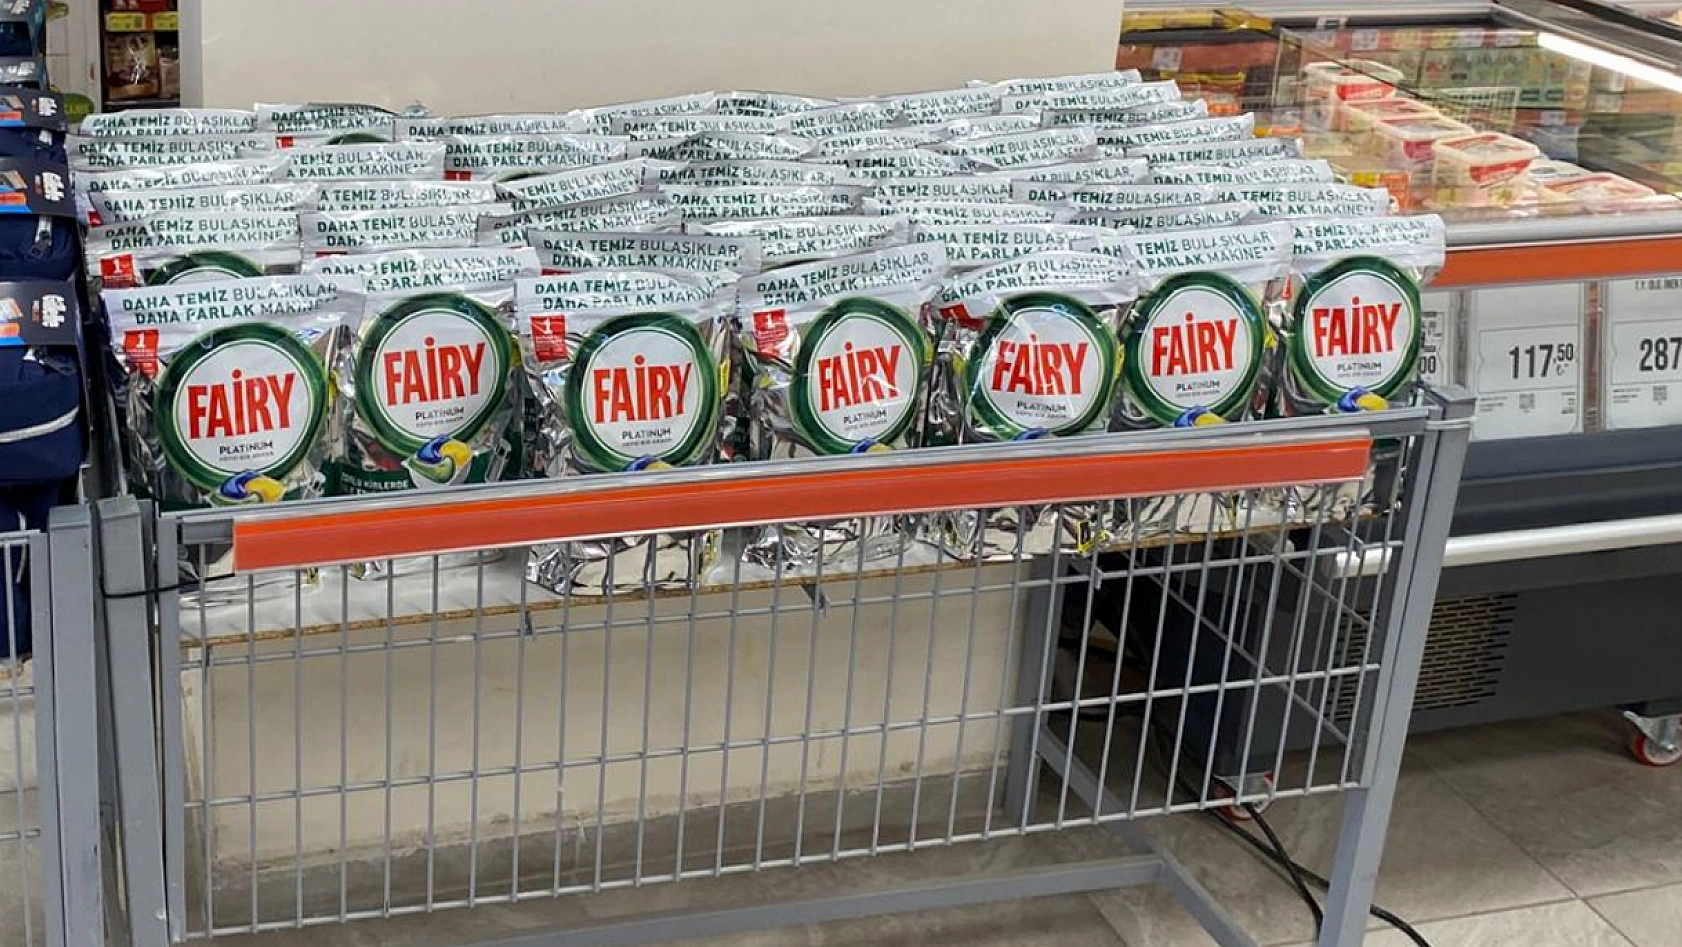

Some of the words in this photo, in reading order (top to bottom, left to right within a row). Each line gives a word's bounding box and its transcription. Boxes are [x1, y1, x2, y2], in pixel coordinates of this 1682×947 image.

[130, 113, 170, 127] TEMİZ
[1090, 111, 1124, 123] TEMİZ
[409, 126, 445, 137] DAHA
[450, 121, 486, 135] TEMİZ
[660, 118, 697, 132] TEMİZ
[122, 139, 164, 154] TEMİZ
[446, 143, 481, 154] DAHA
[487, 140, 523, 153] TEMİZ
[129, 154, 186, 166] PARLAK
[453, 157, 488, 168] DAHA
[492, 154, 543, 167] PARLAK
[855, 156, 896, 168] TEMİZ
[1179, 149, 1212, 163] TEMİZ
[300, 165, 355, 178] PARLAK
[660, 168, 696, 180] DAHA
[701, 163, 740, 178] TEMİZ
[335, 188, 377, 202] TEMİZ
[889, 182, 928, 197] TEMİZ
[1241, 188, 1284, 202] TEMİZ
[149, 195, 195, 211] TEMİZ
[715, 191, 757, 205] TEMİZ
[1073, 192, 1113, 204] TEMİZ
[722, 205, 780, 218] PARLAK
[317, 220, 358, 233] DAHA
[363, 213, 405, 231] TEMİZ
[111, 236, 152, 250] DAHA
[544, 239, 585, 251] DAHA
[590, 235, 634, 250] TEMİZ
[964, 230, 1008, 244] TEMİZ
[1135, 238, 1179, 257] TEMİZ
[552, 253, 592, 267] DAHA
[597, 253, 657, 267] PARLAK
[1148, 253, 1204, 270] PARLAK
[535, 280, 580, 294] DAHA
[585, 278, 630, 293] TEMİZ
[757, 276, 800, 293] DAHA
[801, 265, 838, 286] TEMİZ
[122, 297, 171, 312] DAHA
[176, 287, 228, 306] TEMİZ
[764, 291, 807, 307] DAHA
[811, 278, 858, 302] PARLAK
[136, 309, 180, 324] DAHA
[186, 302, 254, 322] PARLAK
[136, 334, 145, 348] 1
